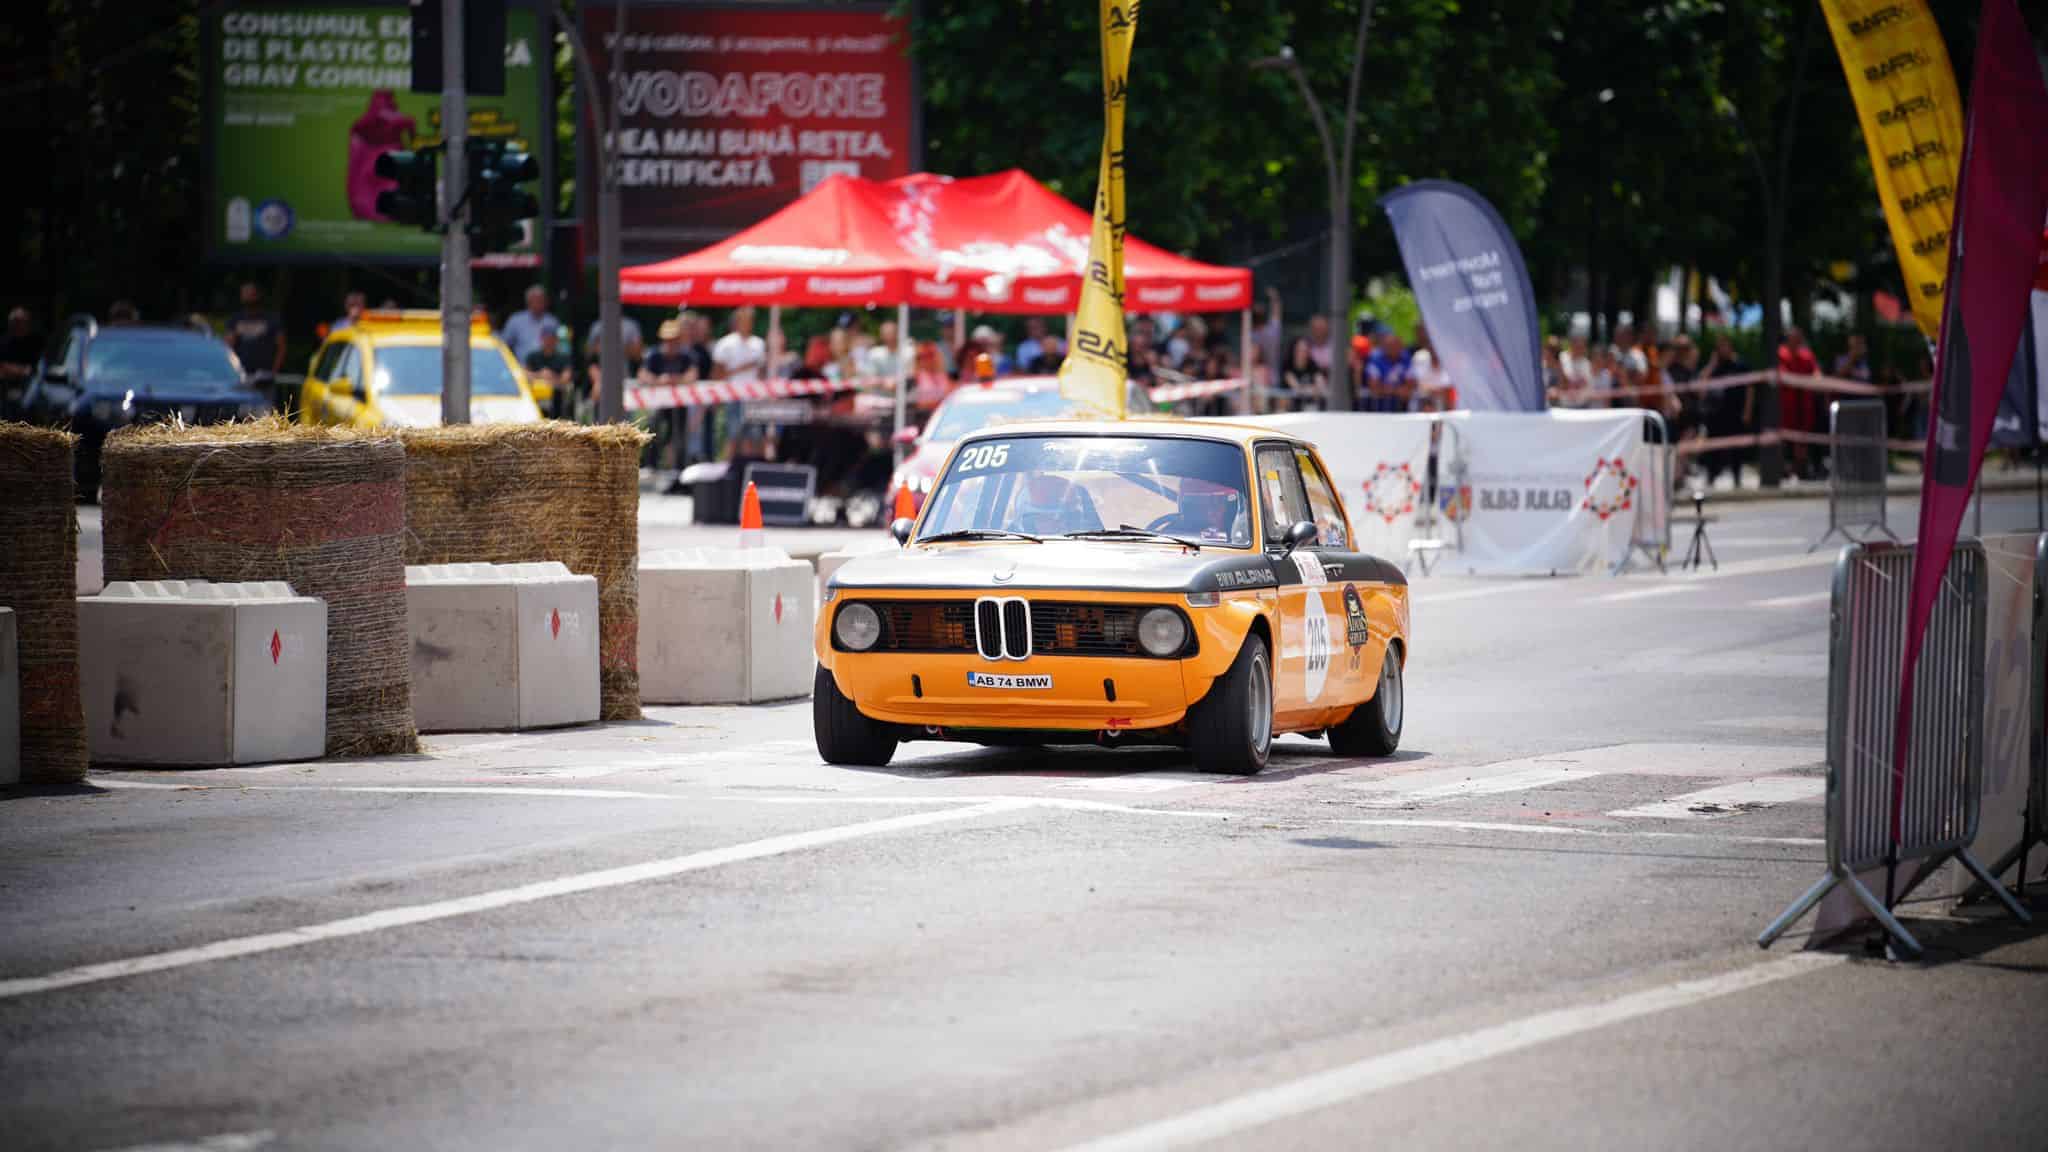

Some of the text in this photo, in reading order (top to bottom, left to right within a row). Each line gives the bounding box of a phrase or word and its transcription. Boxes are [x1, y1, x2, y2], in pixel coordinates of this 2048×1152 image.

[223, 15, 374, 36] CONSUMUL
[223, 39, 257, 60] DE
[265, 39, 378, 62] PLASTIC
[223, 64, 298, 86] GRAV
[609, 70, 887, 118] VODAFONE
[663, 130, 716, 155] MAI
[718, 124, 796, 157] BUNĂ
[958, 443, 1012, 473] 205
[1307, 617, 1328, 672] 205
[976, 675, 1050, 689] AB 74 BMW
